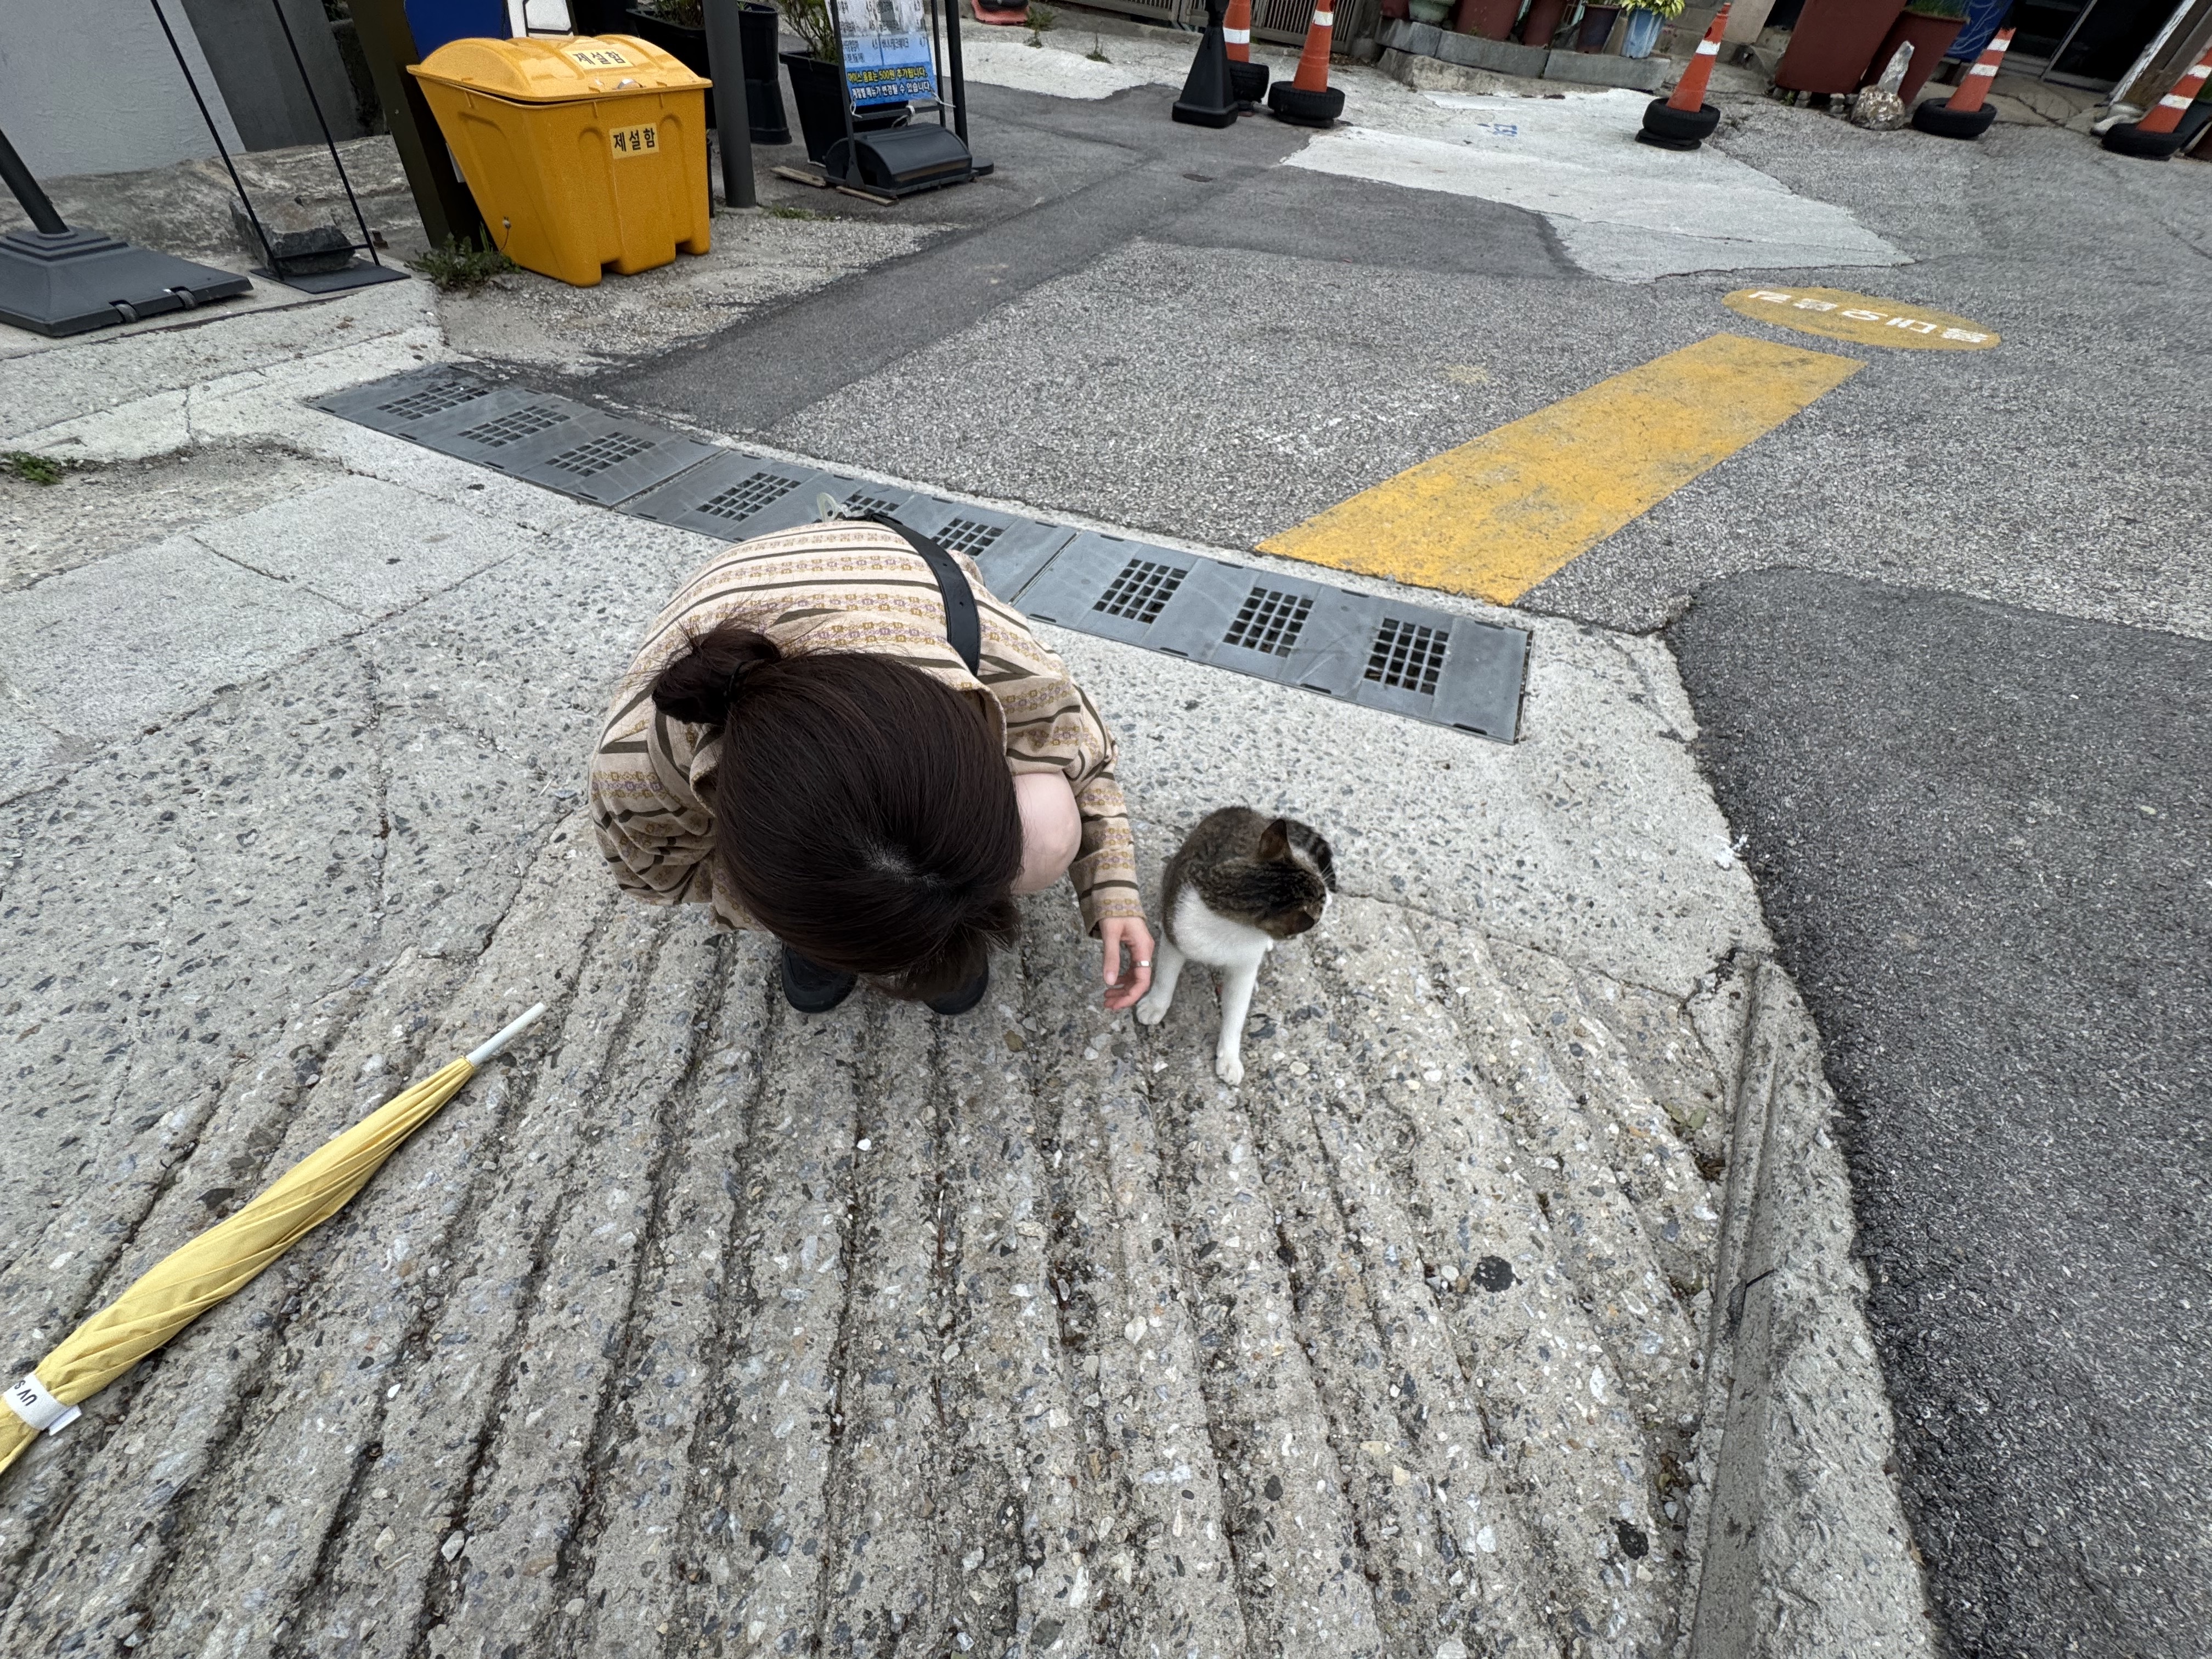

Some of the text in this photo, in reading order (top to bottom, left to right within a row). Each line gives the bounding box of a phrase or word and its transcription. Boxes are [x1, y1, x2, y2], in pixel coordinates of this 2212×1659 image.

[573, 51, 625, 65] 제설함
[848, 66, 928, 83] 아이스 음료는 500원 추가됩니다.
[882, 84, 898, 96] 변경될
[900, 83, 905, 94] 수
[613, 128, 656, 152] 제설함
[16, 1389, 38, 1406] UV
